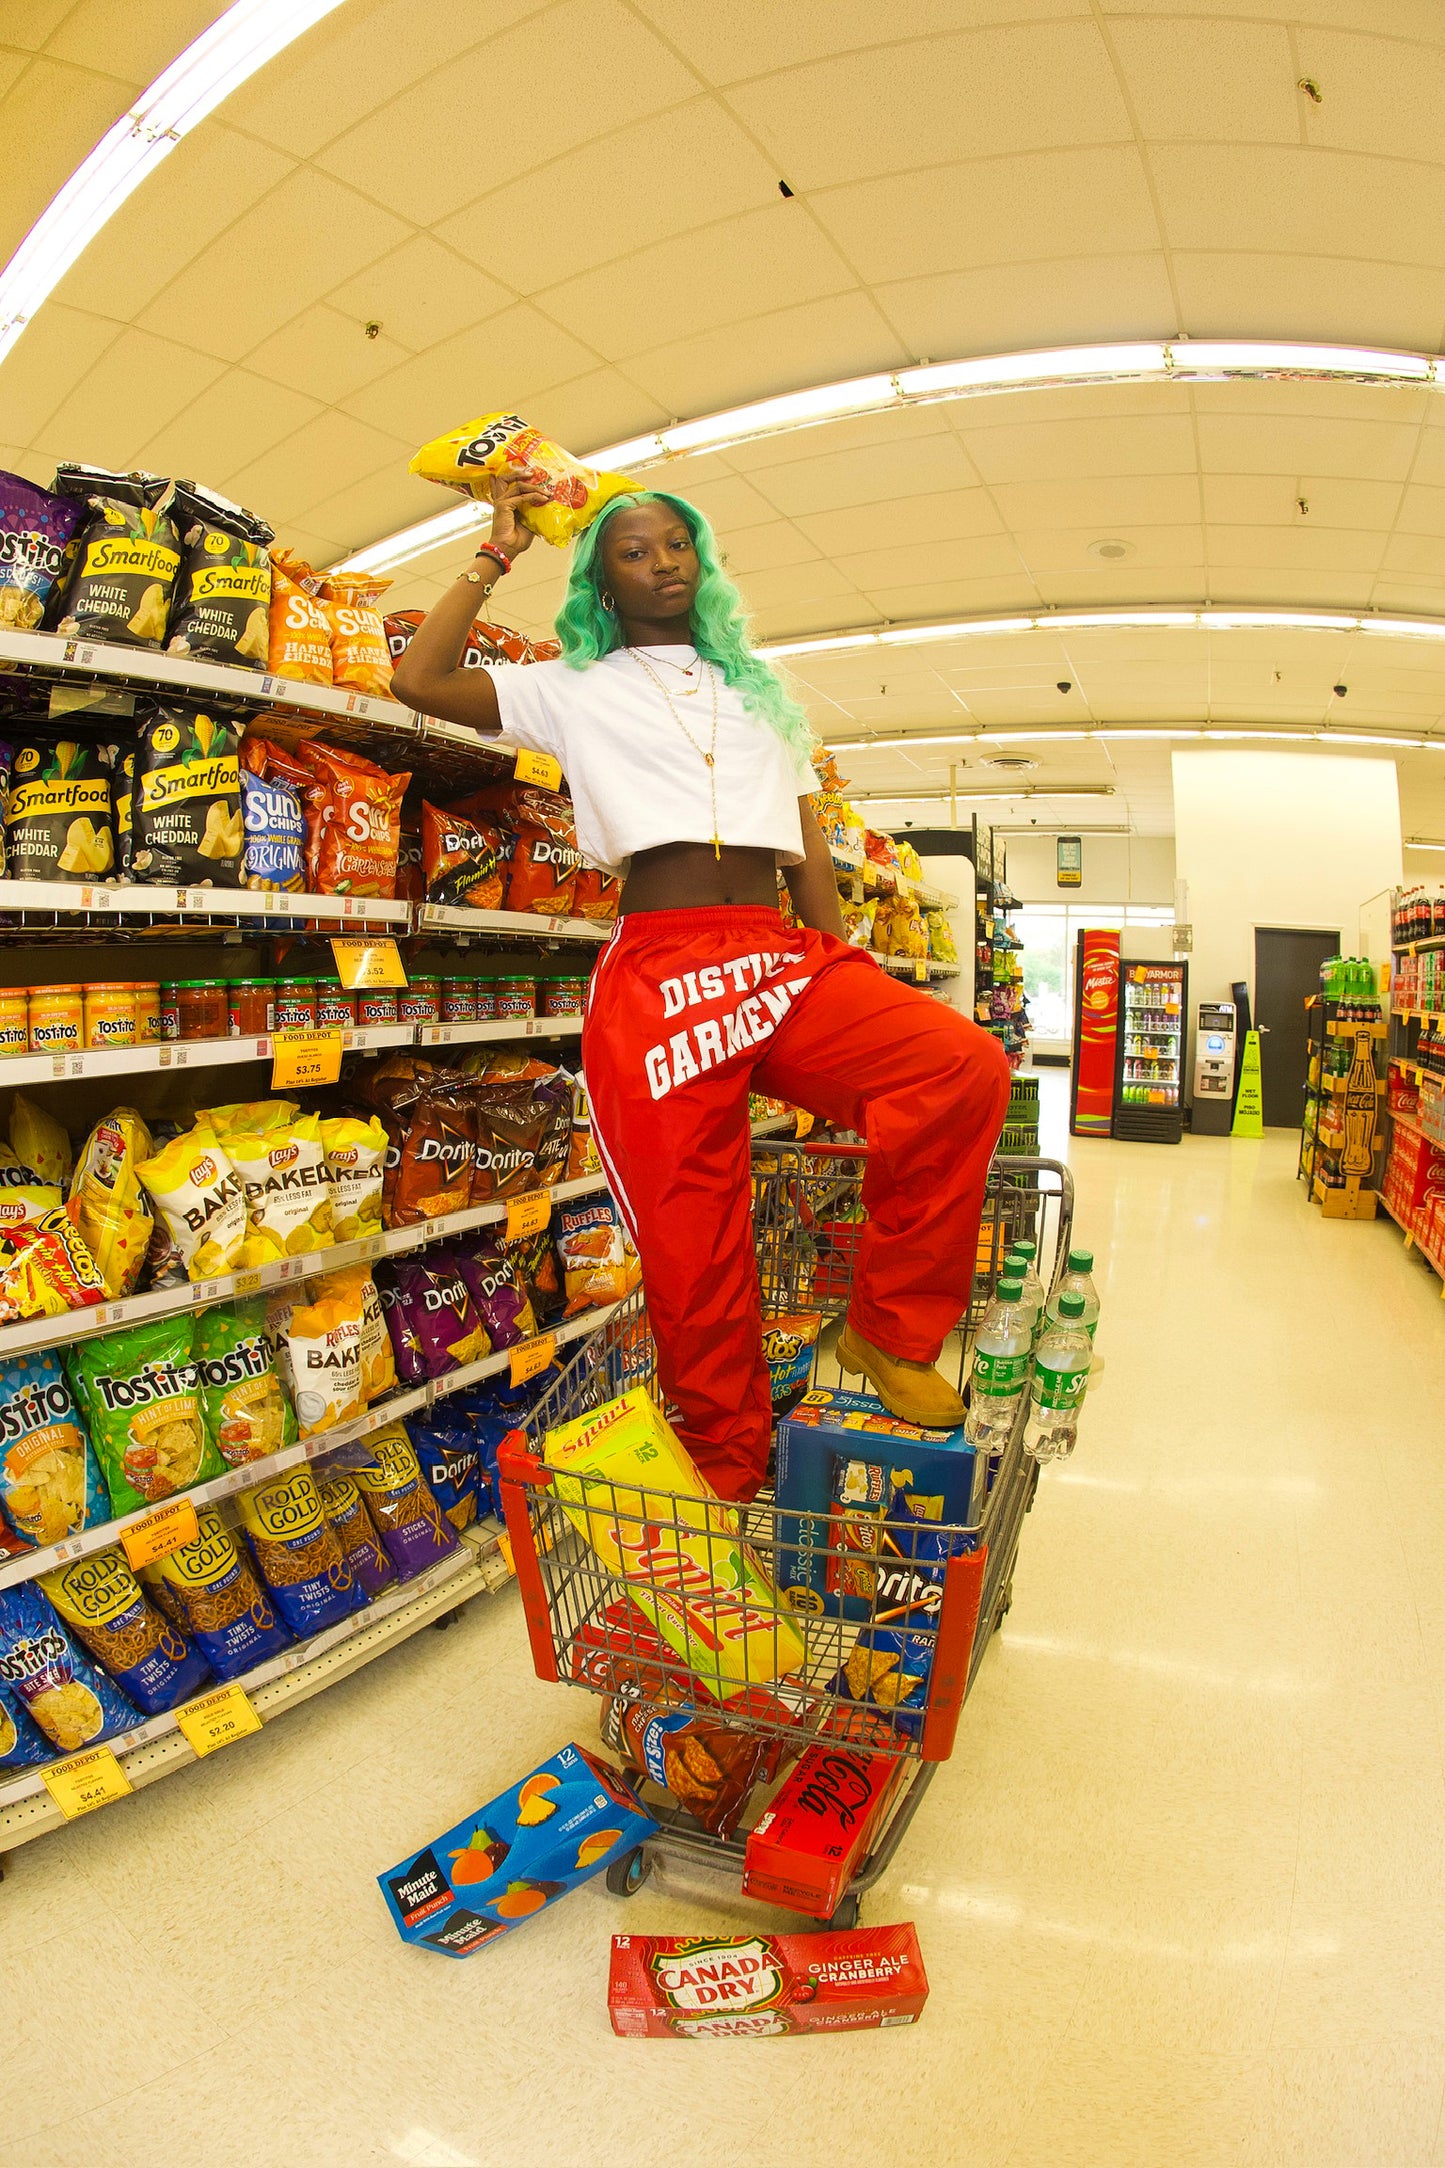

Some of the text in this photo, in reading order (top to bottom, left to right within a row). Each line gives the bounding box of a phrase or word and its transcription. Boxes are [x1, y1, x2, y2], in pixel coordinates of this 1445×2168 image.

[457, 415, 529, 467] TOSTIT
[210, 534, 224, 546] 70
[89, 584, 128, 602] WHITE
[199, 571, 270, 595] Smartfo
[76, 599, 131, 620] CHEDDAR
[199, 607, 235, 626] WHITE
[187, 621, 238, 642] CHEDDAR
[158, 728, 173, 741] 70
[151, 768, 239, 801] Smartfoo
[10, 787, 109, 814] Smartfood
[244, 790, 302, 832] Sun
[153, 815, 192, 829] WHITE
[269, 816, 303, 832] CHIPS
[13, 829, 51, 842] WHITE
[145, 830, 199, 847] CHEDDAR
[445, 833, 487, 852] Dori
[5, 843, 58, 859] CHEDDAR
[244, 844, 305, 871] ORIGIN
[342, 940, 388, 948] FOOD DEPOT
[1129, 969, 1180, 979] BYARMOR
[500, 999, 532, 1011] TOSTITOS
[33, 1024, 78, 1041] TOSTITOS
[283, 1031, 332, 1041] FOOD DEPOT
[295, 1063, 321, 1075] $3.75
[270, 1144, 299, 1168] Lay's
[421, 1139, 476, 1162] Dorito
[475, 1147, 535, 1171] Dorito
[190, 1156, 217, 1187] Lay's
[183, 1171, 243, 1233] BAKE
[285, 1190, 313, 1202] LESS FAT
[334, 1198, 358, 1208] original
[284, 1206, 309, 1217] original
[561, 1207, 613, 1232] RUFFLES
[521, 1218, 539, 1230] $4.63
[481, 1260, 514, 1297] Dori
[424, 1280, 467, 1311] Dorit
[199, 1337, 275, 1388] TOSTIT
[307, 1343, 361, 1369] BAKE
[95, 1363, 200, 1410] TOSTITO
[0, 1374, 74, 1444] STITO
[137, 1399, 197, 1425] HINT OF LIME
[562, 1398, 630, 1459] Squirt
[16, 1427, 65, 1457] ORIGINAL
[639, 1440, 659, 1462] 12
[633, 1448, 647, 1465] PACK
[432, 1453, 479, 1484] Dorit
[868, 1464, 883, 1502] RUFFLES
[263, 1479, 312, 1509] ROLD
[130, 1505, 180, 1535] FOOD DEPOT
[269, 1497, 320, 1530] GOLD
[304, 1529, 322, 1544] POUND
[402, 1520, 426, 1537] STICKS
[402, 1526, 432, 1545] ORIGINAL
[151, 1536, 177, 1554] $4.41
[186, 1534, 232, 1575] GOLD
[348, 1545, 370, 1563] STICKS
[796, 1518, 820, 1585] classic
[69, 1554, 118, 1596] ROLD
[609, 1518, 784, 1641] Squirt
[789, 1564, 797, 1580] MIX
[82, 1572, 131, 1613] GOLD
[299, 1586, 331, 1603] TWISTS
[302, 1580, 322, 1593] TINY
[876, 1565, 945, 1612] orito
[301, 1593, 337, 1611] ORIGINAL
[225, 1625, 256, 1648] TWISTS
[227, 1622, 247, 1637] TINY
[0, 1630, 67, 1680] OSTITOS
[227, 1633, 263, 1656] ORIGINAL
[140, 1657, 159, 1675] TINY
[141, 1660, 171, 1687] TWISTS
[24, 1678, 41, 1693] BITE
[147, 1666, 179, 1696] ORIGINAL
[184, 1690, 231, 1715] FOOD DEPOT
[209, 1721, 236, 1737] $2.20
[647, 1720, 665, 1759] Size!
[51, 1753, 100, 1777] FOOD DEPOT
[557, 1748, 575, 1765] 12
[563, 1757, 578, 1769] Cans
[793, 1752, 819, 1783] SUGAR
[80, 1786, 107, 1803] $4.41
[797, 1754, 873, 1834] Cola
[828, 1844, 844, 1857] 12
[397, 1870, 438, 1900] Minute
[406, 1882, 438, 1908] Maid
[409, 1907, 427, 1921] Fruit
[426, 1895, 449, 1912] Punch
[437, 1918, 482, 1945] Minute
[452, 1926, 488, 1946] Maid
[615, 1936, 631, 1945] 12
[689, 1954, 738, 1967] SINCE 1904
[808, 1954, 910, 1975] GINGER ALE
[833, 1953, 864, 1961] CAFFEINE
[657, 1952, 783, 1991] CANADA
[818, 1965, 902, 1983] CRANBERRY
[696, 1976, 759, 2005] DRY
[650, 2009, 667, 2017] 12
[676, 2013, 791, 2033] CANADA
[809, 2008, 897, 2023] GINGER ALE
[711, 2027, 766, 2038] DRY
